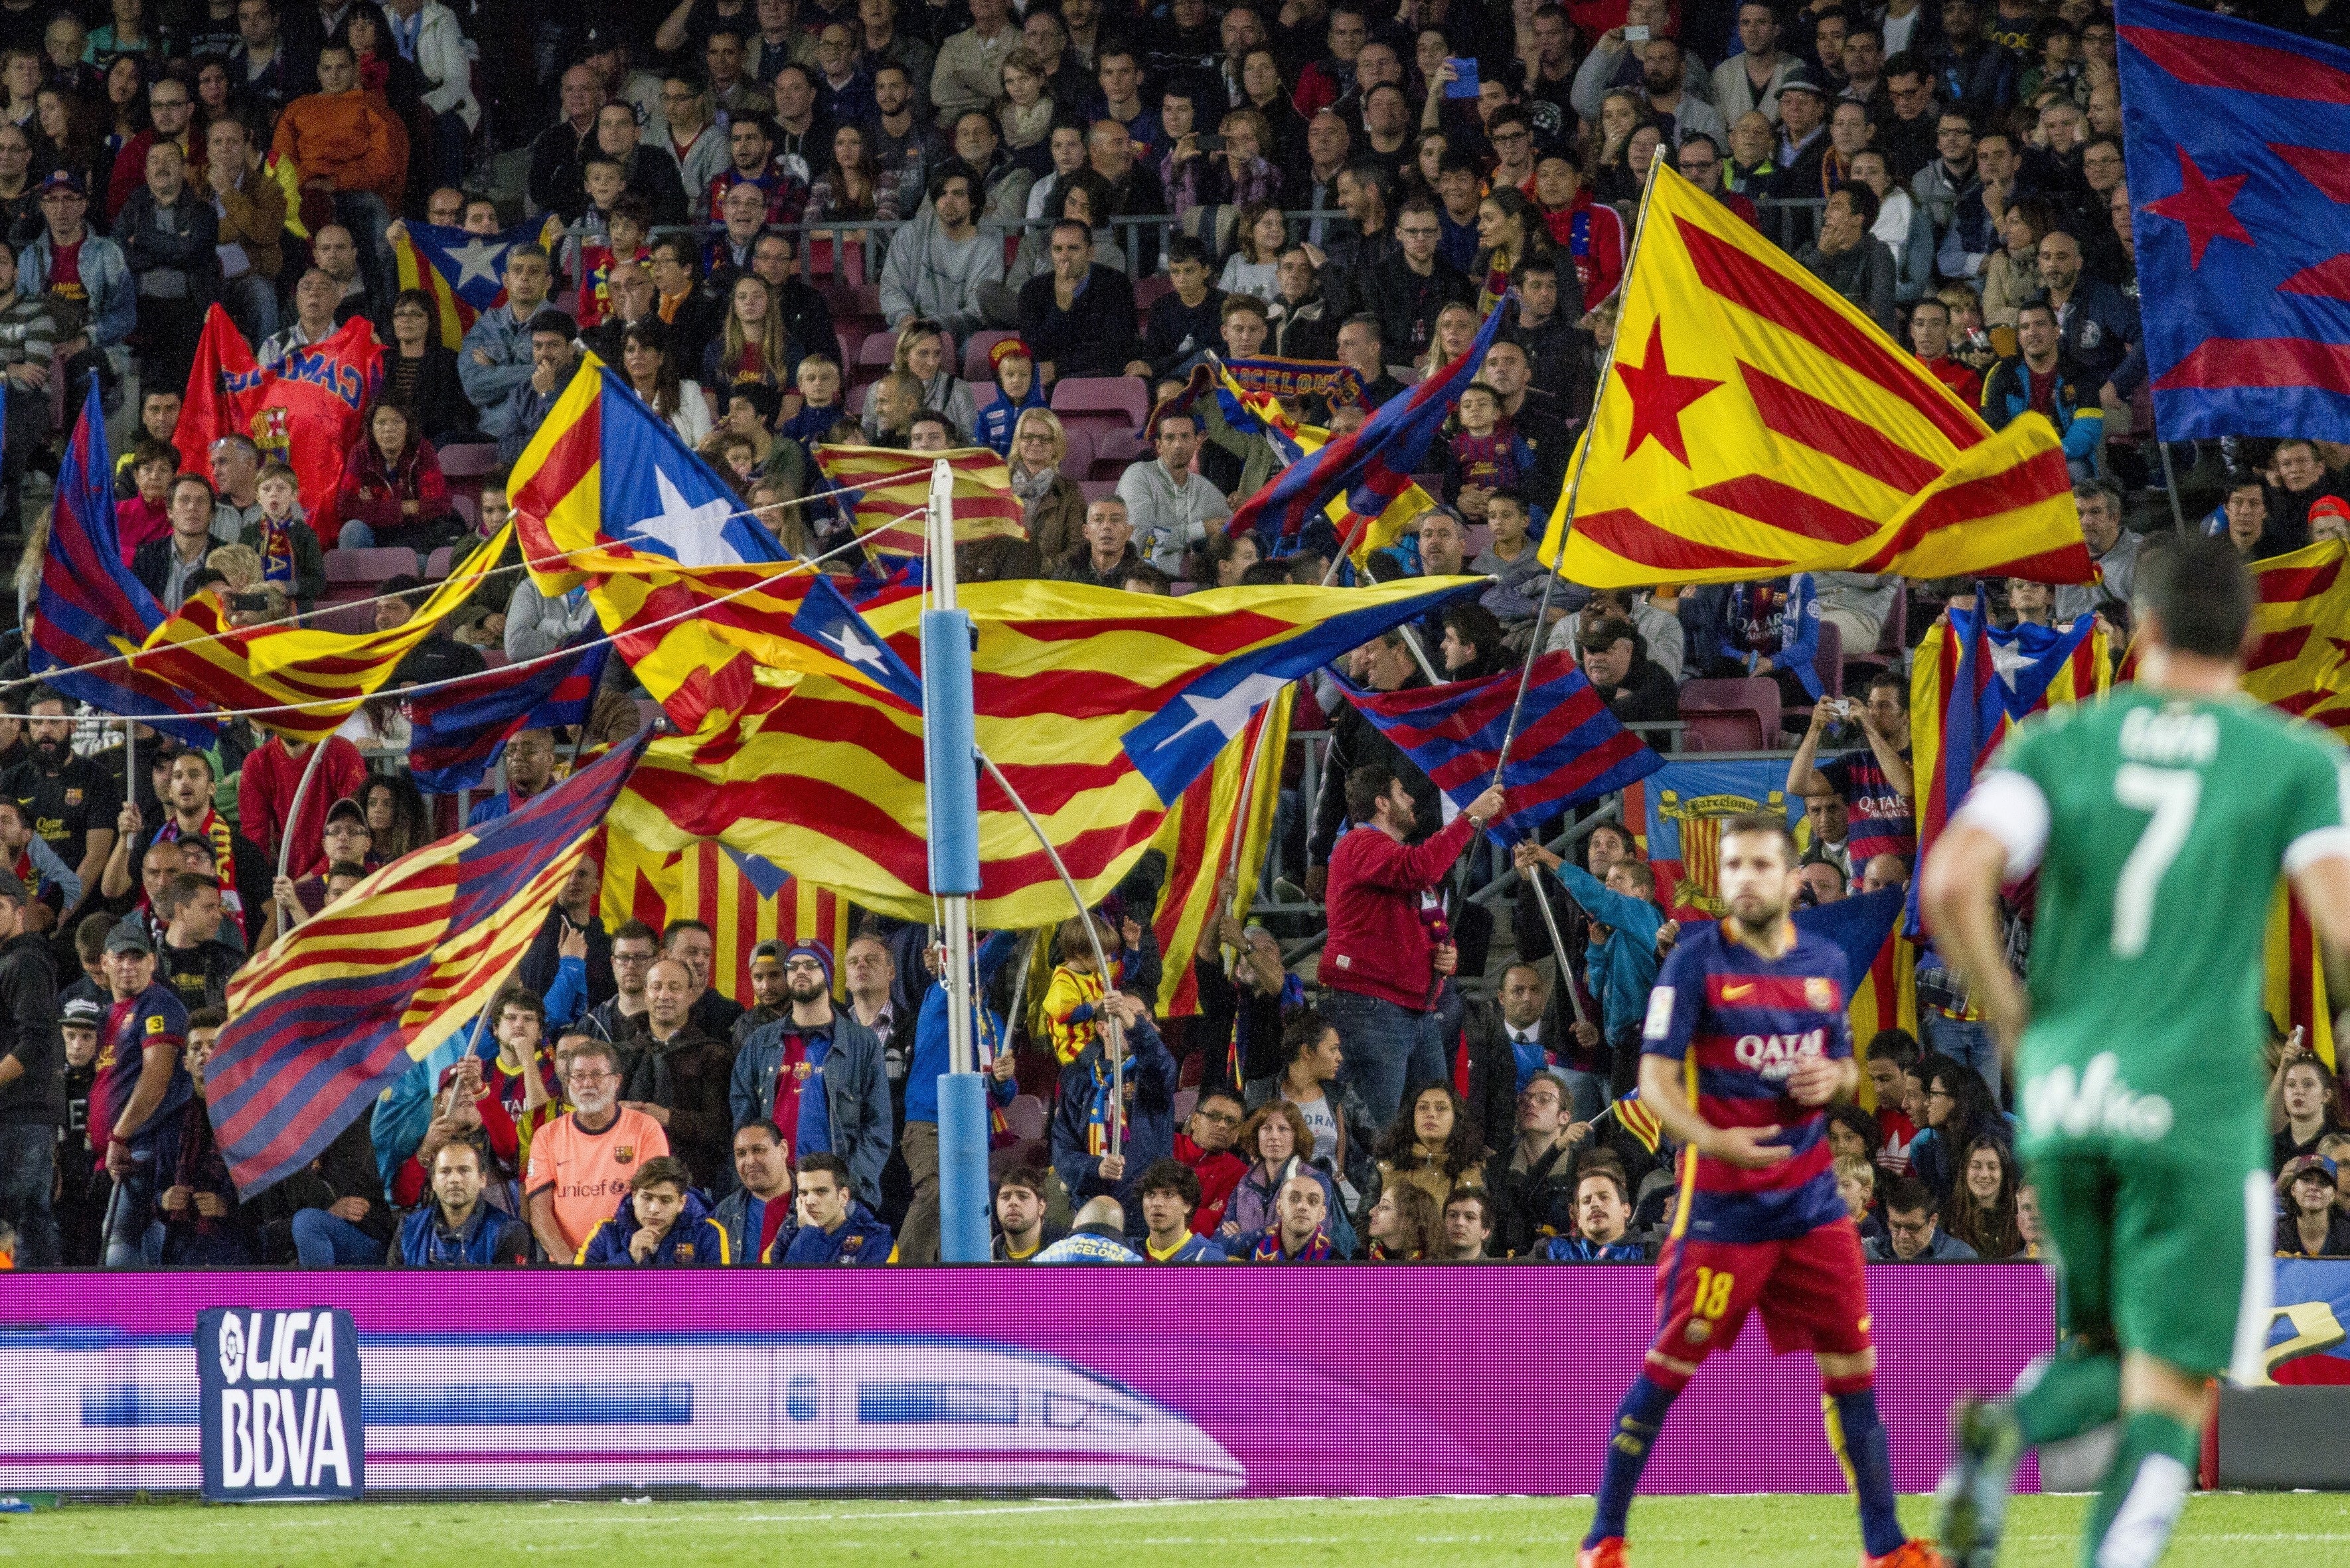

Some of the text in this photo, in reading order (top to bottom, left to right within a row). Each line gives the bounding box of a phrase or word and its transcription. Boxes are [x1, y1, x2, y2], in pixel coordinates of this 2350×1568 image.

[2111, 763, 2203, 961] 7
[556, 1179, 607, 1198] unicef
[1692, 1266, 1735, 1320] 18
[246, 1312, 334, 1381] LIGA
[221, 1387, 352, 1488] BBVA
